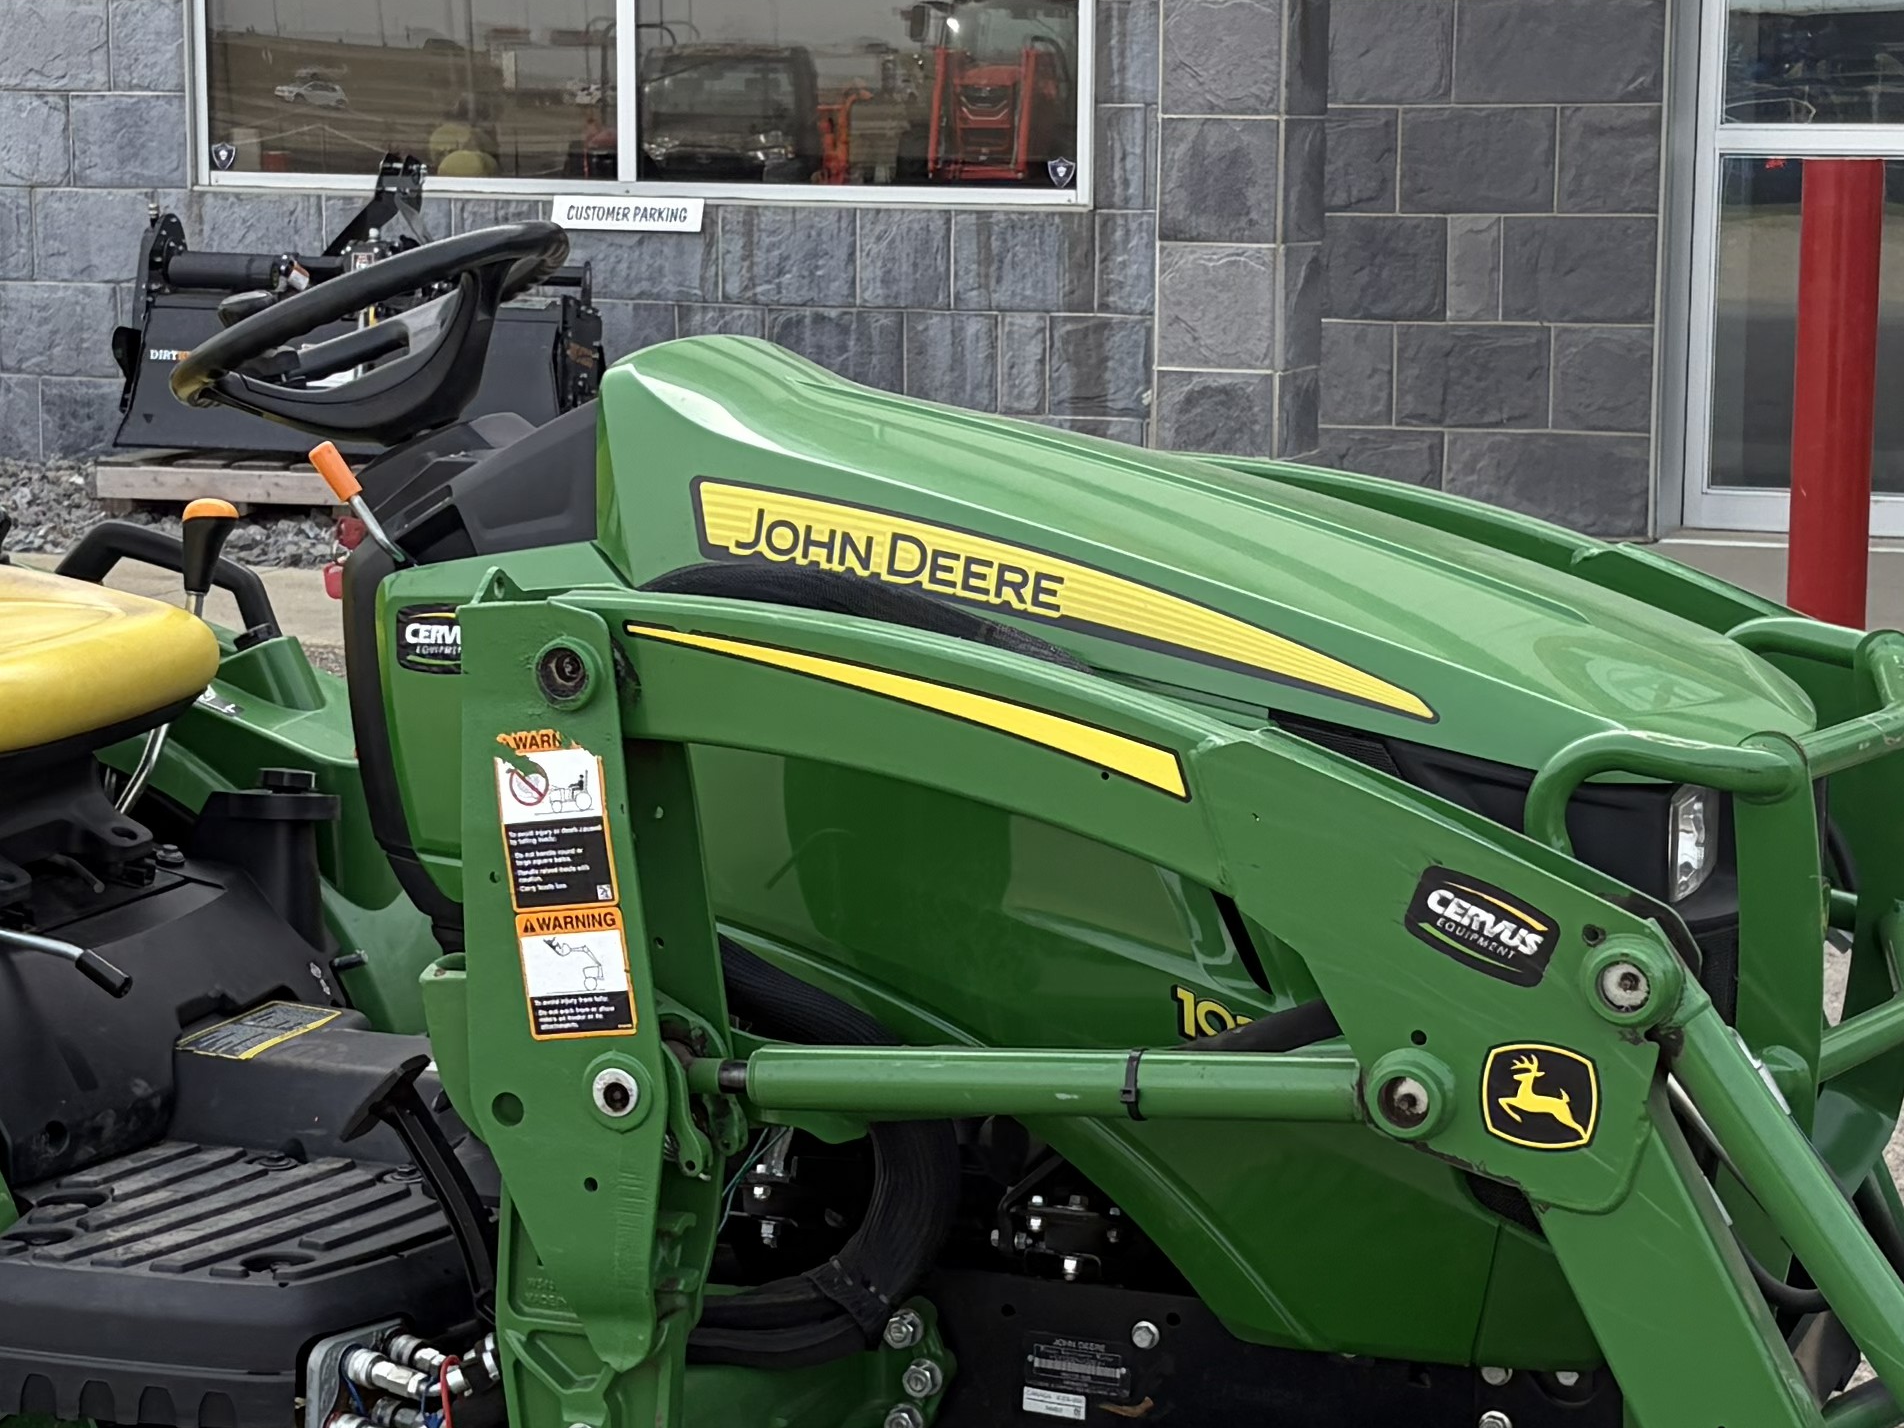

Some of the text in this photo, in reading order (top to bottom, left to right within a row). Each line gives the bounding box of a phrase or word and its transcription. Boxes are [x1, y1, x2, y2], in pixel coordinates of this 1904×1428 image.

[567, 205, 688, 223] CUSTOMER PARKING
[735, 508, 1065, 613] JOHN DEERE
[536, 912, 616, 931] WARNING
[1426, 889, 1544, 955] CERVUS
[1436, 917, 1516, 959] EQUIPMENT
